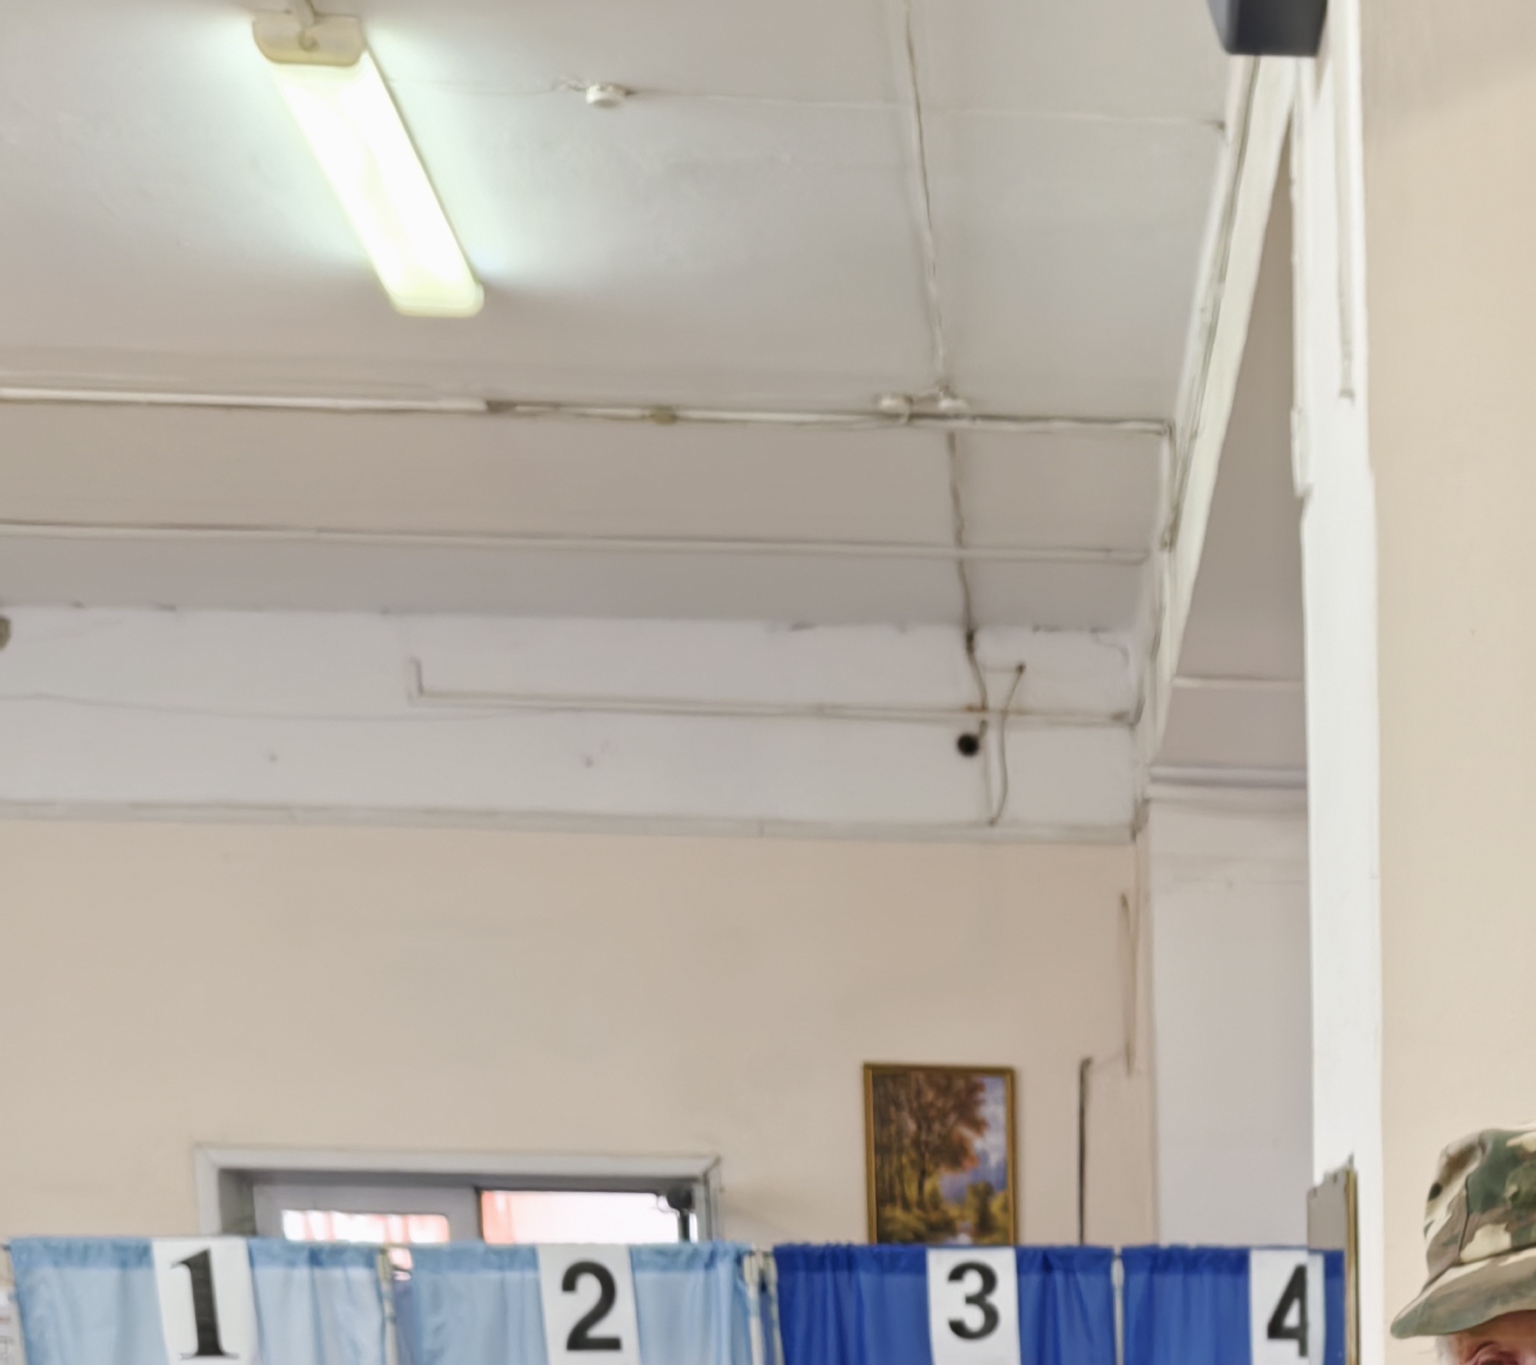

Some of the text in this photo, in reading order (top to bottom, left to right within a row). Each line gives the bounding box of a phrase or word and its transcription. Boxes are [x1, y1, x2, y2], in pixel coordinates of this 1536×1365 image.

[169, 1249, 240, 1360] 1
[560, 1260, 623, 1352] 2
[946, 1261, 1000, 1341] 3
[1266, 1263, 1309, 1358] 4
